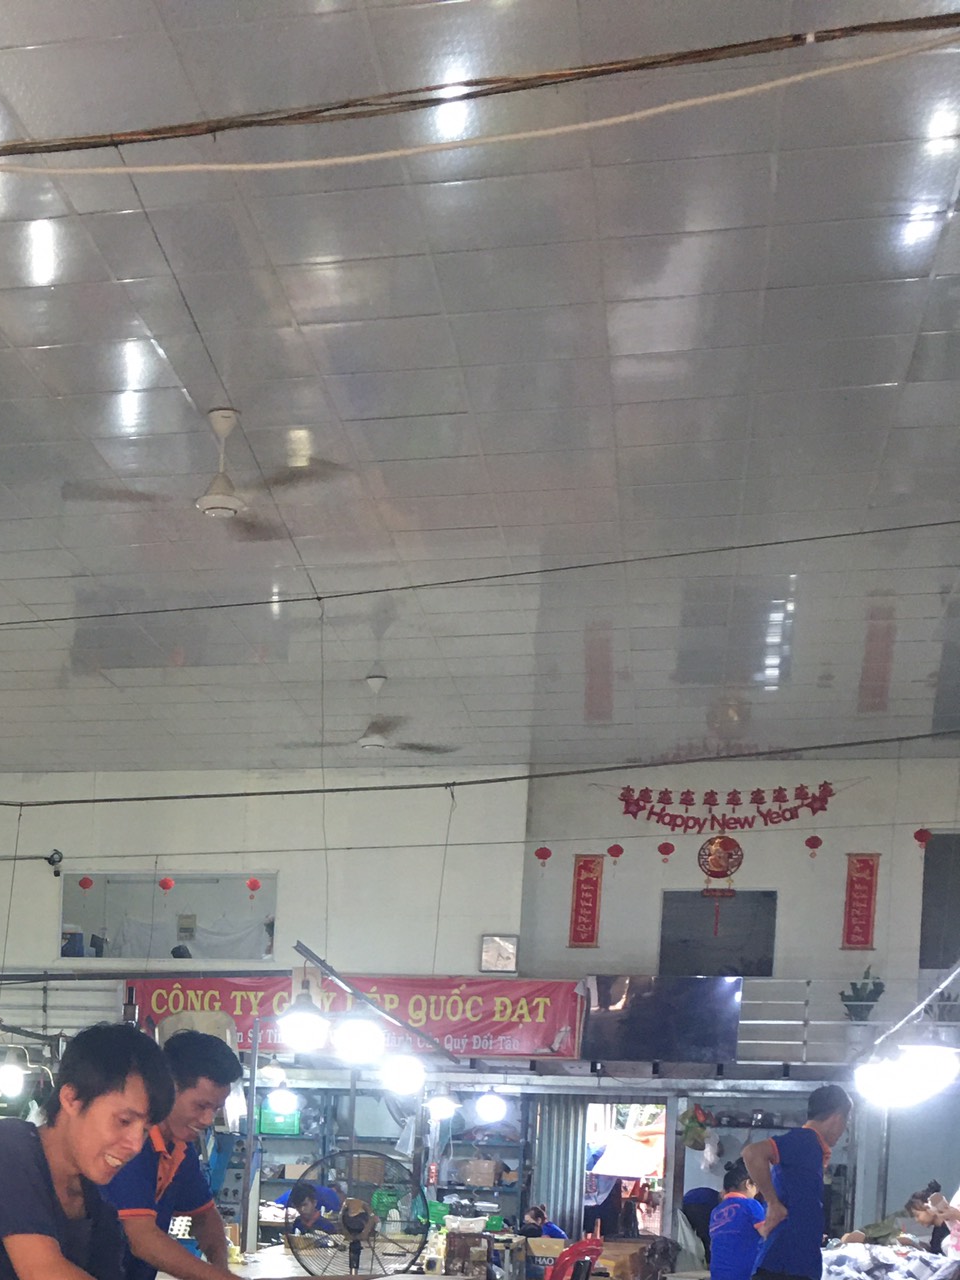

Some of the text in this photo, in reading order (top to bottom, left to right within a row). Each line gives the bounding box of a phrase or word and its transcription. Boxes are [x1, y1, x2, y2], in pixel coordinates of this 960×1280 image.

[646, 804, 802, 834] Happy New Year
[151, 983, 222, 1015] CÔNG
[230, 991, 265, 1016] TY
[408, 983, 483, 1027] QUỐC
[493, 996, 551, 1029] ĐẠT
